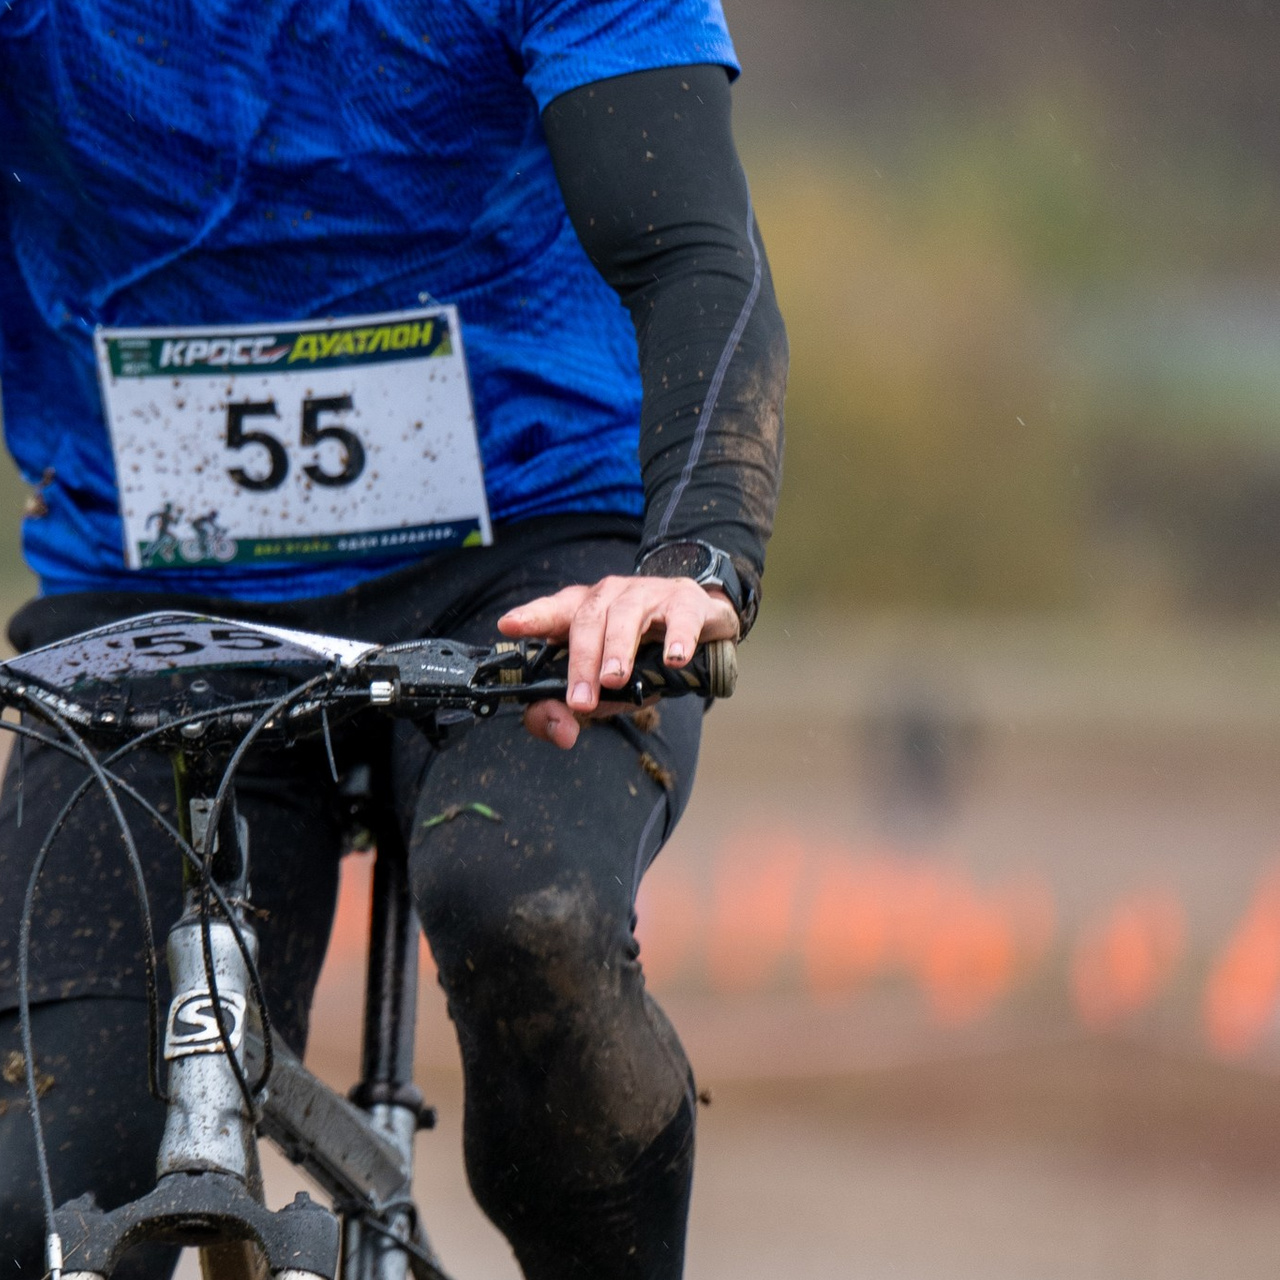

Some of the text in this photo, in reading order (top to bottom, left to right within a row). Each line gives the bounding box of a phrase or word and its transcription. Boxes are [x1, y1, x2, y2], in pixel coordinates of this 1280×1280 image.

[158, 336, 282, 368] КРОСС
[287, 321, 434, 364] ДУАТЛОН
[225, 394, 366, 492] 55
[132, 629, 284, 658] 55
